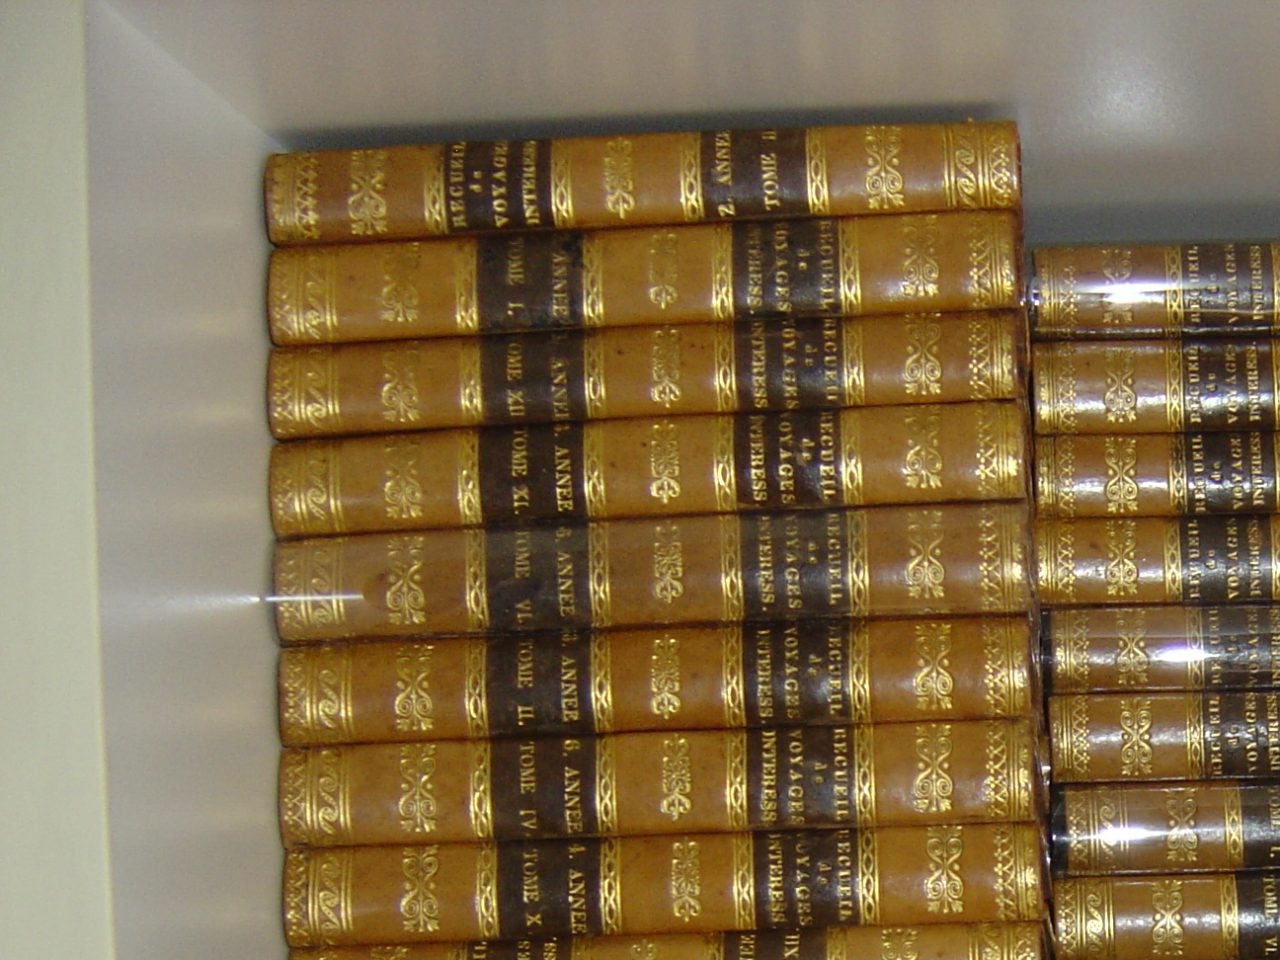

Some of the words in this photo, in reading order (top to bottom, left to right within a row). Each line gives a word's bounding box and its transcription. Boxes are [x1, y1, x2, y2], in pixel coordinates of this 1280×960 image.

[450, 142, 467, 227] RECUEIL
[761, 153, 780, 210] TOME
[551, 253, 569, 317] ANNEE
[511, 429, 528, 477] TOME
[554, 446, 573, 512] ANNEE
[820, 412, 836, 500] RECUEIL
[512, 486, 529, 515] XI.
[514, 531, 531, 578] TOME
[556, 552, 576, 617] ANNEE
[827, 513, 842, 605] RECUEIL
[518, 642, 533, 688] TOME
[561, 656, 578, 722] ANNEE
[784, 627, 799, 719] VOYAGES
[520, 742, 536, 794] TOME
[564, 766, 582, 833] ANNEE
[788, 730, 805, 825] VOYAGES
[814, 762, 827, 784] de
[833, 728, 849, 821] RECUEIL
[523, 849, 539, 903] TOME
[568, 869, 587, 934] ANNEE
